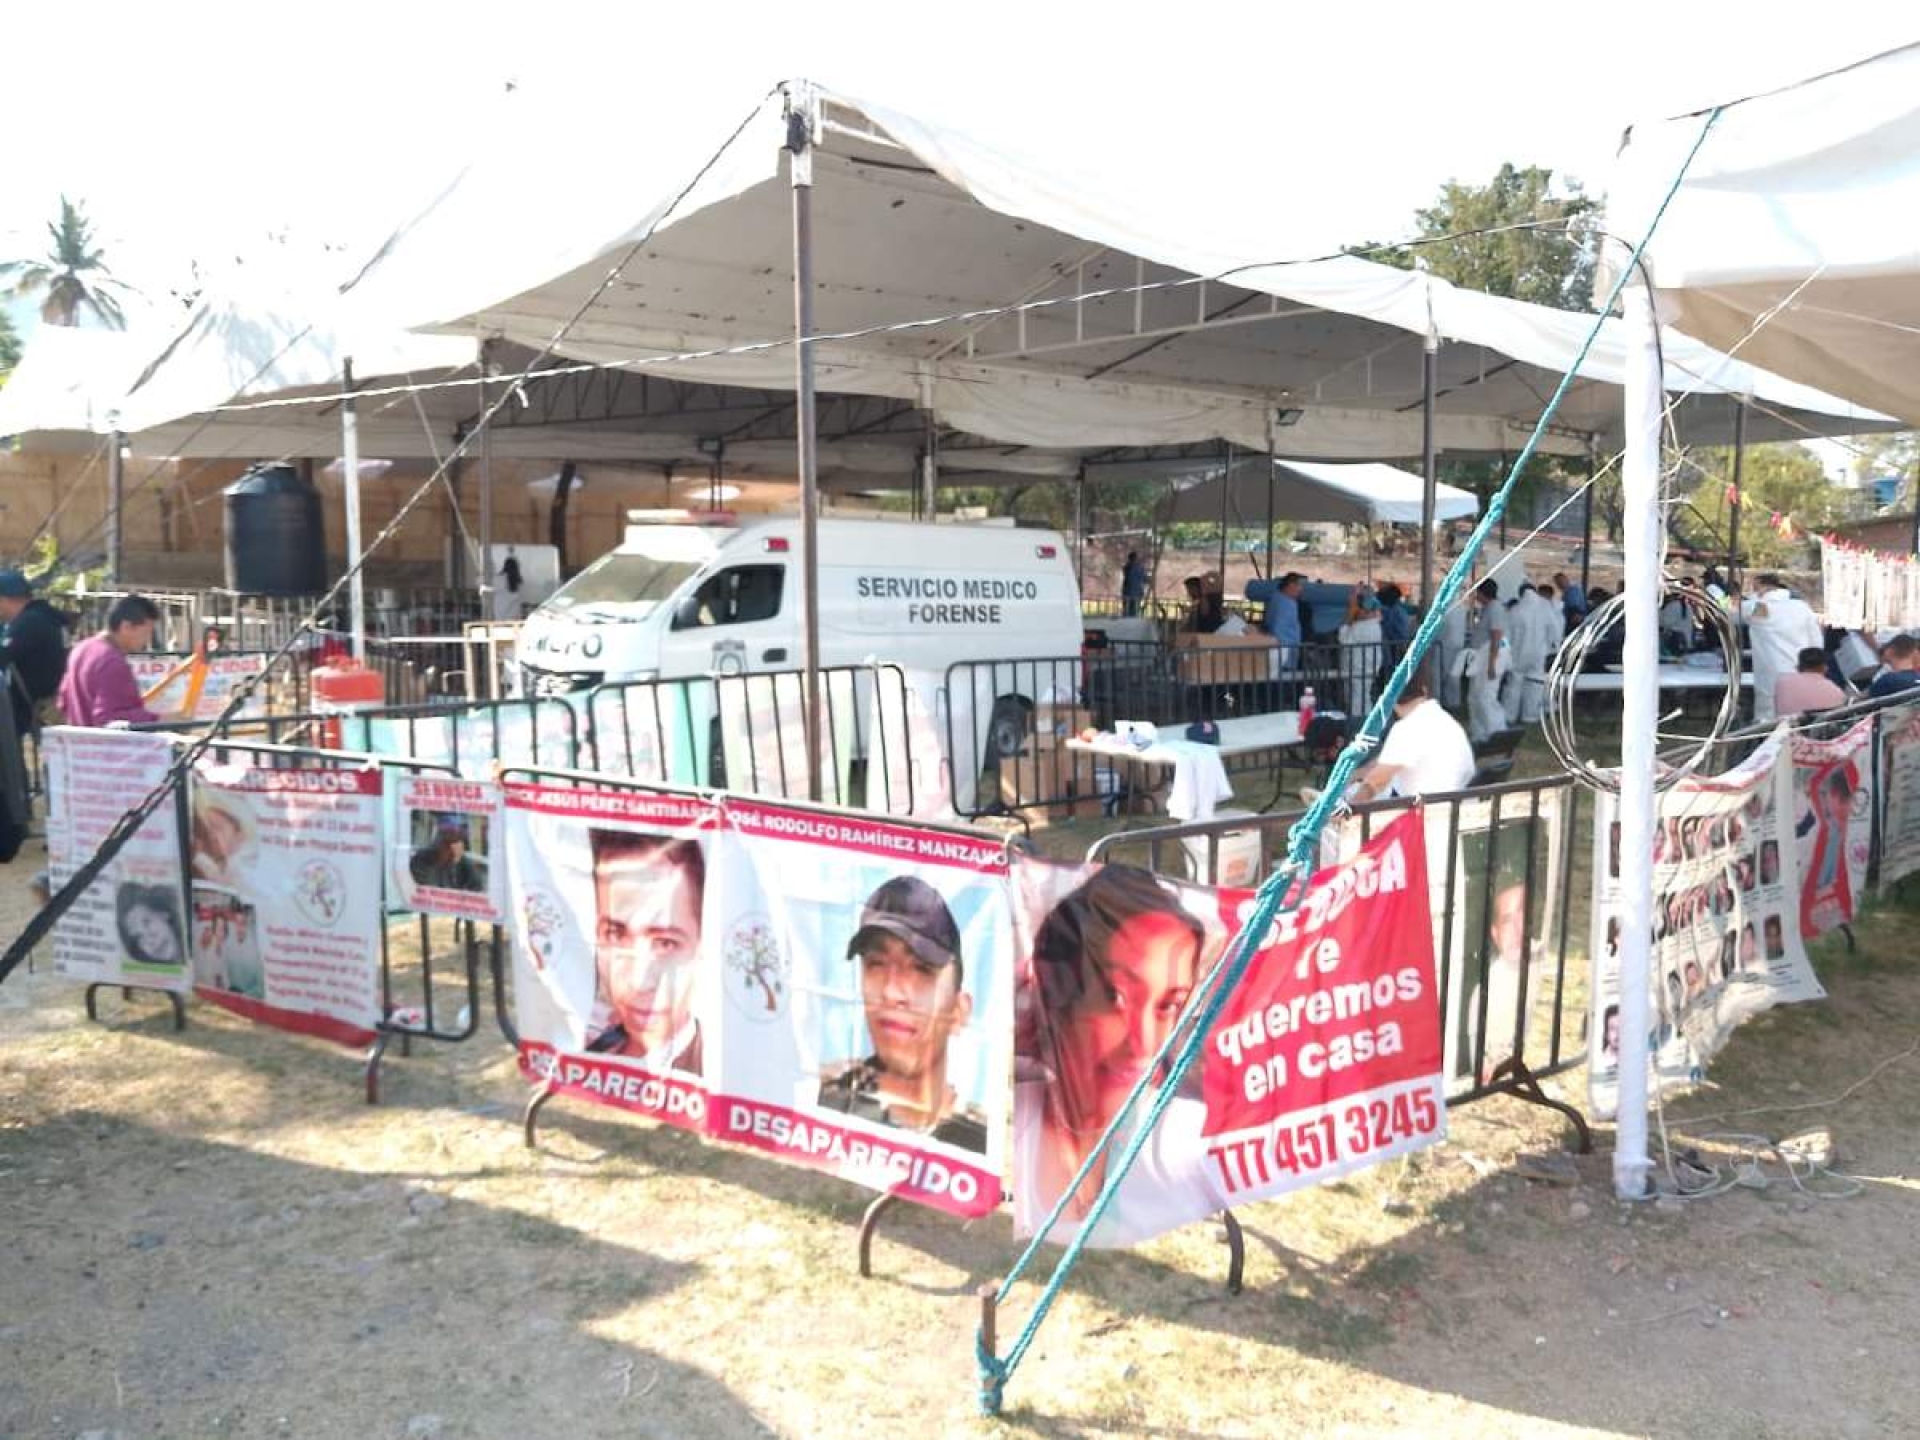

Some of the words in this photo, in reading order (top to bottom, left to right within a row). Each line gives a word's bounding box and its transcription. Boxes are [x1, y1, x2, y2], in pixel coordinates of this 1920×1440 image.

[857, 577, 958, 599] SERVICIO
[963, 580, 1038, 600] MEDICO
[909, 604, 1002, 624] FORENSE
[763, 814, 838, 842] RODOLFO
[840, 828, 914, 852] RAMÍREZ
[1216, 967, 1423, 1067] queremos
[1244, 1053, 1288, 1103] en
[1298, 1021, 1404, 1079] casa
[729, 1104, 978, 1204] DESAPARECIDO
[1208, 1137, 1270, 1194] 777
[1275, 1113, 1338, 1175] 451
[1345, 1087, 1438, 1154] 3245
